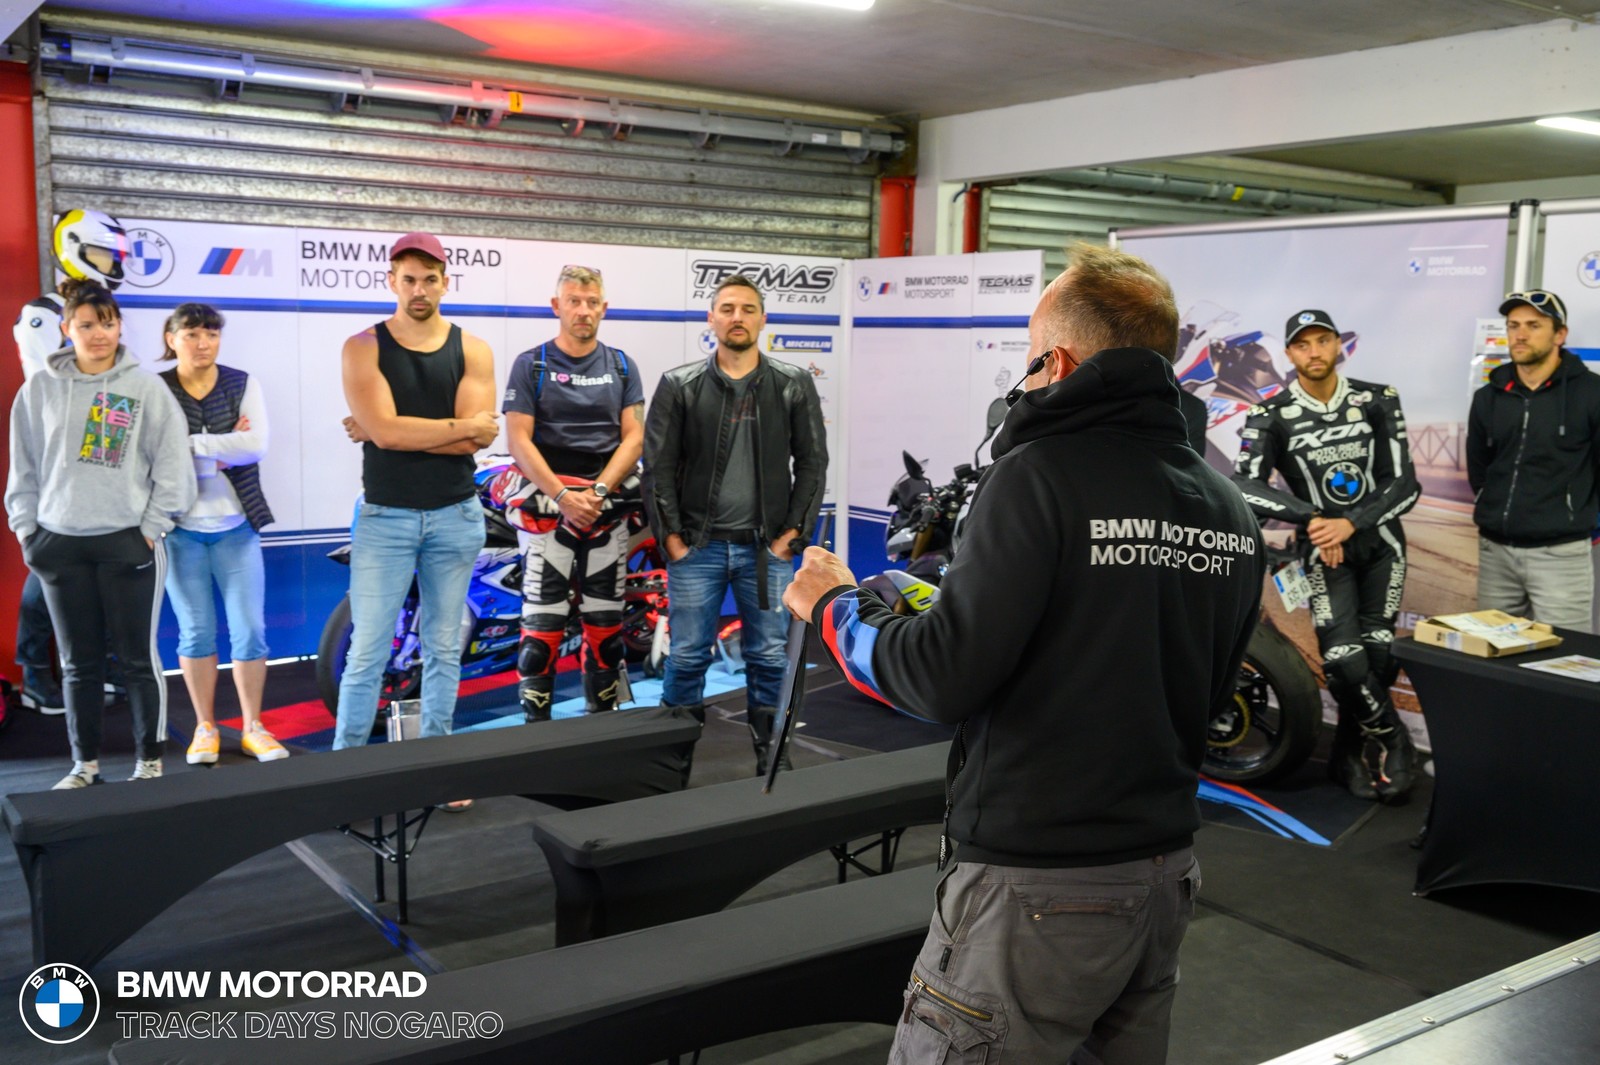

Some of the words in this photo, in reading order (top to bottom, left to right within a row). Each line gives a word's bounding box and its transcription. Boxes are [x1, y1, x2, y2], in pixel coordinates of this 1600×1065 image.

[301, 241, 362, 261] BMW
[368, 244, 501, 267] MRRAD
[1428, 256, 1454, 266] BMW
[1426, 266, 1487, 276] MOTORRAD
[301, 269, 464, 292] MOTORT
[904, 277, 924, 286] BMW
[925, 276, 968, 286] MOTORRAD
[977, 276, 1034, 287] TECMAS
[777, 293, 827, 304] TEAM
[904, 288, 955, 299] MOTORSPORT
[785, 340, 832, 349] MICHELIN
[1306, 446, 1337, 461] MOTO
[1337, 441, 1363, 455] RIDE
[1316, 448, 1368, 466] TOULOUSE
[1089, 518, 1156, 539] BMW
[1160, 521, 1255, 555] MOTORRAD
[1090, 544, 1235, 576] MOTORSPORT
